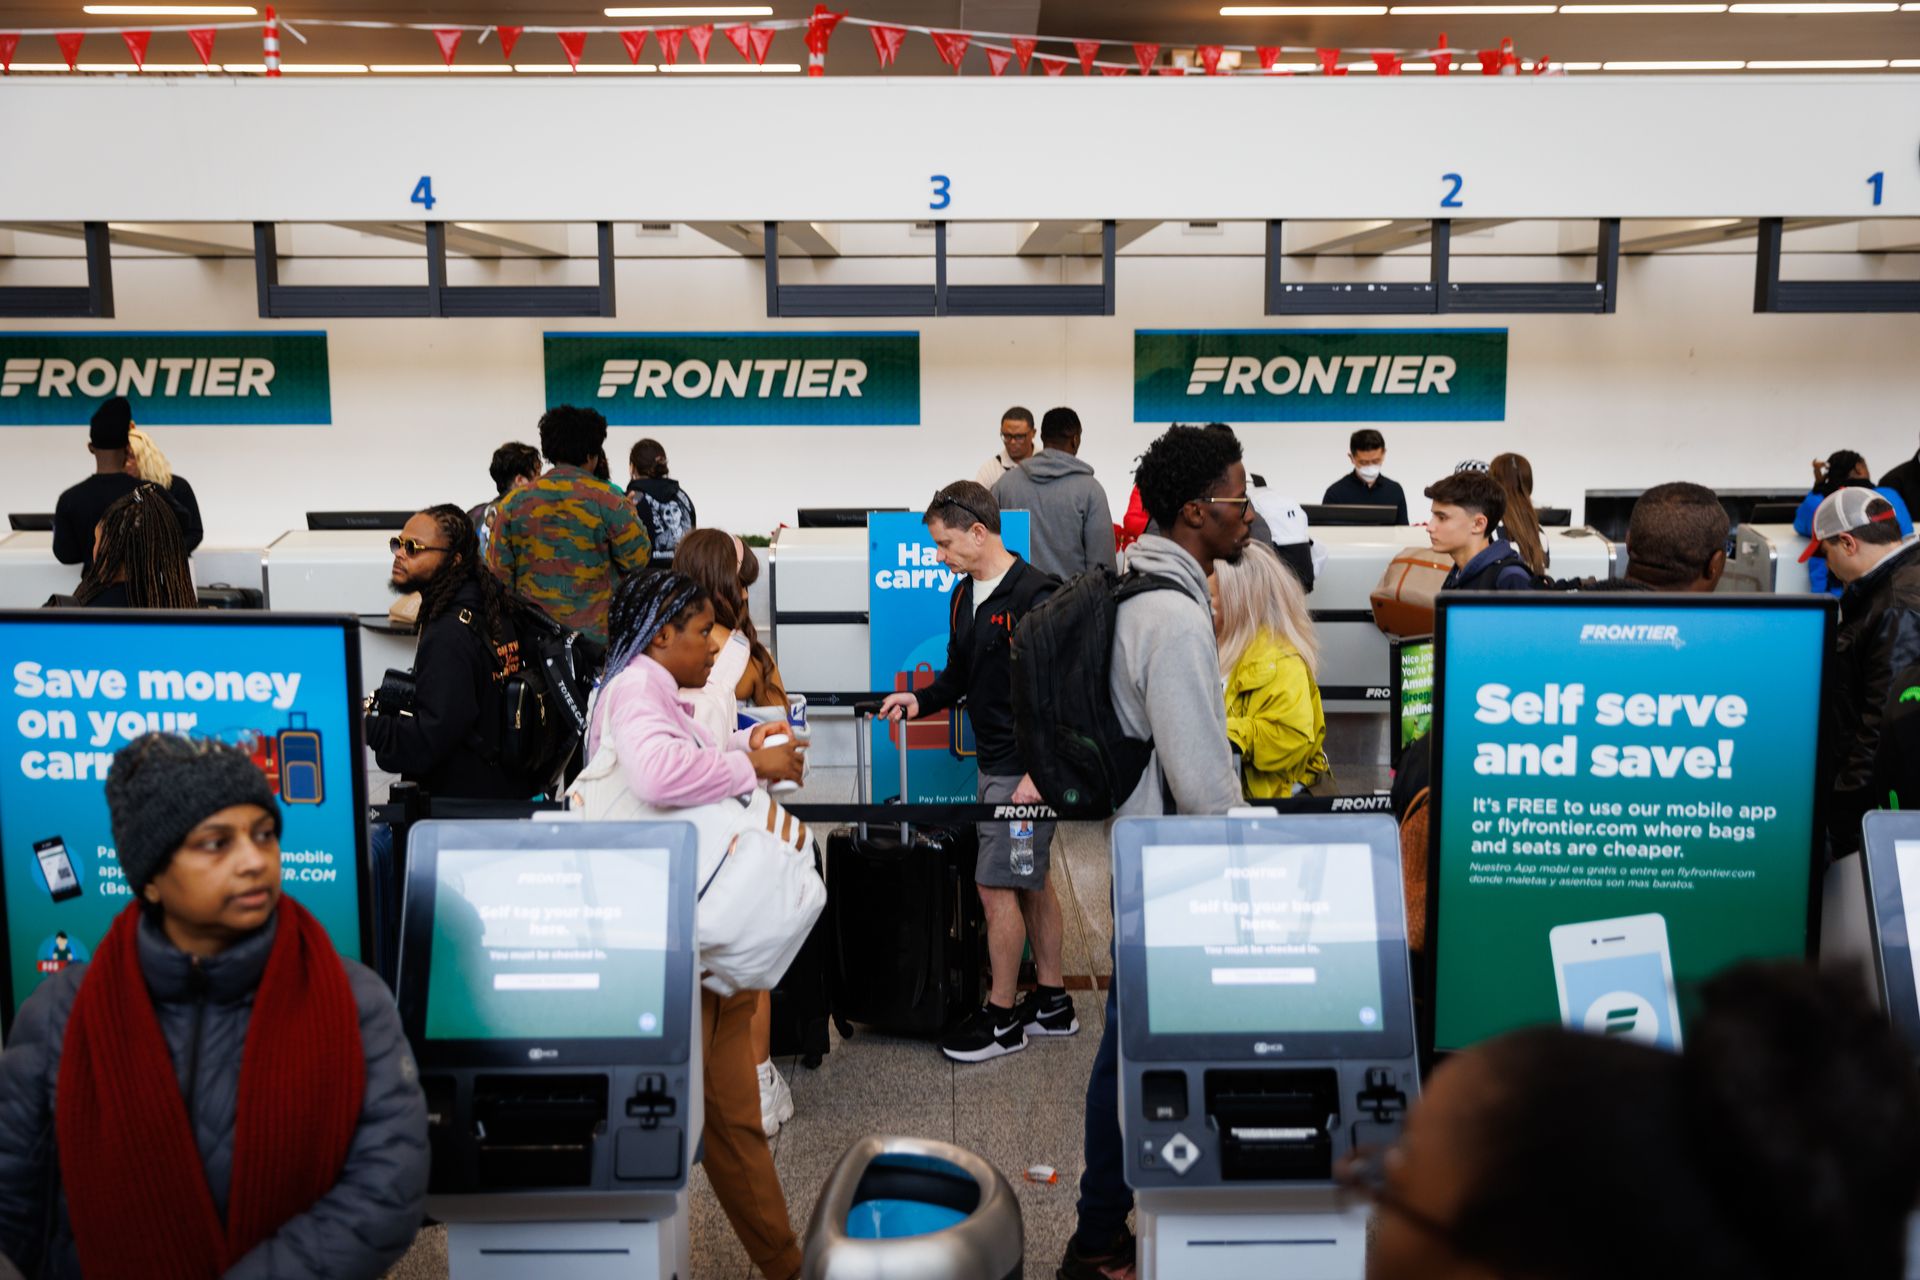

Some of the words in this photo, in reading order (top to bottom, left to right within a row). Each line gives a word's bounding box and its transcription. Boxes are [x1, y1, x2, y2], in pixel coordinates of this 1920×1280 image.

[410, 176, 437, 211] 4
[929, 175, 952, 210] 3
[1440, 173, 1463, 208] 2
[1866, 171, 1885, 206] 1
[0, 357, 276, 398] FRONTIER
[597, 358, 868, 399] FRONTIER
[1187, 354, 1457, 396] FRONTIER
[898, 542, 939, 567] Ha
[1580, 624, 1678, 641] FRONTIER
[1402, 655, 1419, 666] Nice
[1402, 666, 1425, 677] You're
[14, 661, 127, 699] Save
[139, 667, 301, 709] money
[1365, 688, 1390, 699] FRO
[1475, 683, 1584, 725] Self
[1596, 694, 1748, 727] serve
[17, 709, 77, 739] on
[88, 711, 197, 747] your
[20, 750, 115, 780] carr
[1474, 735, 1578, 777] and
[1591, 739, 1734, 779] save!
[918, 795, 933, 804] Pay
[950, 796, 968, 804] your
[1331, 797, 1392, 811] FRONTI
[1473, 797, 1501, 814] It's
[1506, 798, 1557, 815] FREE
[1563, 799, 1584, 815] to
[1590, 802, 1622, 816] use
[1628, 802, 1661, 817] our
[1666, 801, 1733, 819] mobile
[1739, 805, 1777, 822] app
[1471, 819, 1492, 833] or
[1497, 817, 1637, 837] flyfrontier.com
[1643, 821, 1703, 838] where
[1708, 823, 1755, 842] bags
[97, 845, 116, 859] Pa
[280, 850, 333, 863] mobile
[1471, 838, 1507, 854] and
[1512, 839, 1561, 855] seats
[1567, 843, 1597, 856] are
[1603, 840, 1684, 860] cheaper.
[1469, 862, 1511, 873] Nuestro
[1514, 863, 1536, 875] App
[1540, 863, 1569, 875] mobil
[1572, 866, 1584, 875] es
[1586, 865, 1617, 877] gratis
[1620, 868, 1627, 876] o
[1630, 866, 1658, 876] entre
[1677, 866, 1755, 879] flyfrontier.com
[1469, 873, 1503, 884] donde
[1505, 874, 1547, 886] maletas
[1559, 875, 1603, 887] asientos
[1606, 879, 1625, 887] son
[1627, 879, 1650, 888] mas
[1653, 878, 1694, 889] baratos.
[99, 882, 133, 896] (Bes
[514, 907, 539, 921] tag
[543, 908, 579, 921] your
[584, 906, 622, 920] bags
[1253, 903, 1288, 916] your
[1292, 900, 1330, 914] bags
[510, 951, 535, 960] must
[537, 951, 549, 960] be
[1225, 944, 1248, 955] must
[1251, 945, 1262, 955] be
